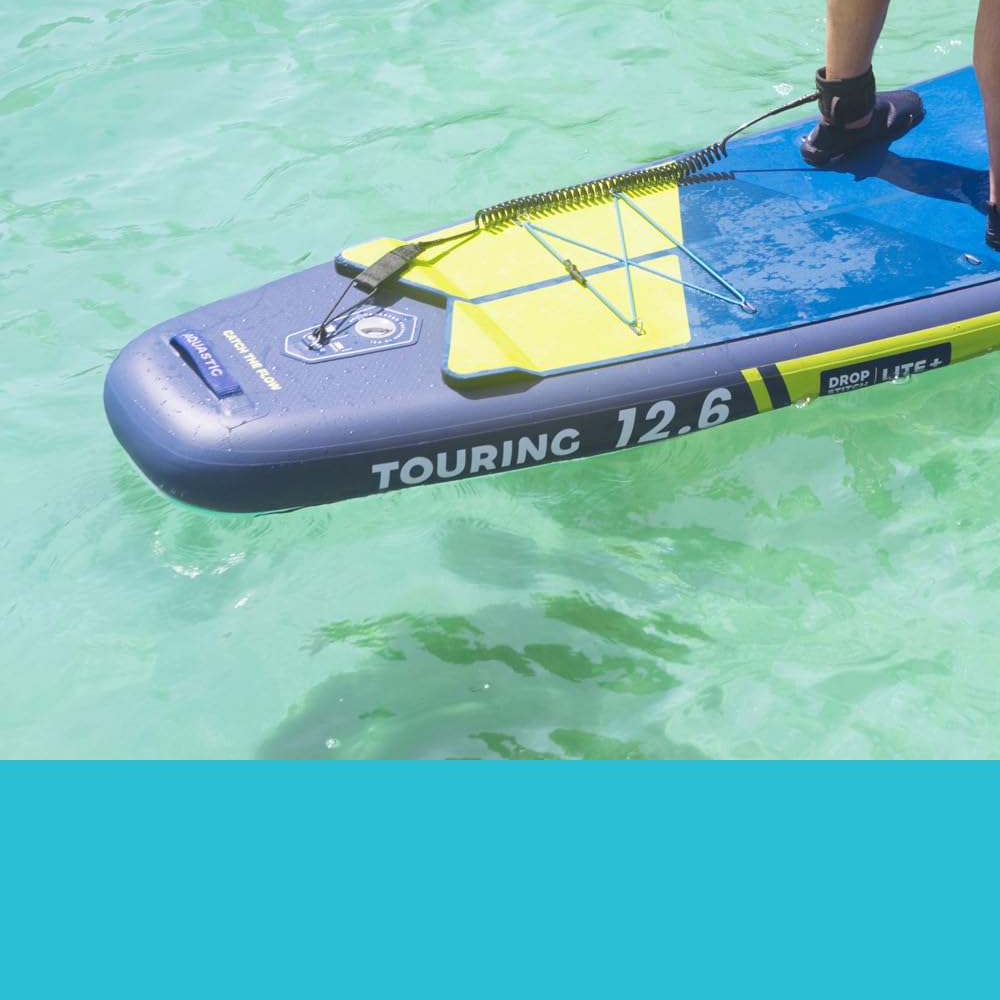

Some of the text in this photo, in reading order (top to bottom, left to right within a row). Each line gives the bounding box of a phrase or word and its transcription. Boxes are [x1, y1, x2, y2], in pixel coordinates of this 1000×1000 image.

[181, 332, 224, 378] AQUASTIC
[223, 329, 283, 391] CATCH THE FLOW
[828, 369, 871, 389] DROP
[371, 387, 733, 490] TOURING 12.6
